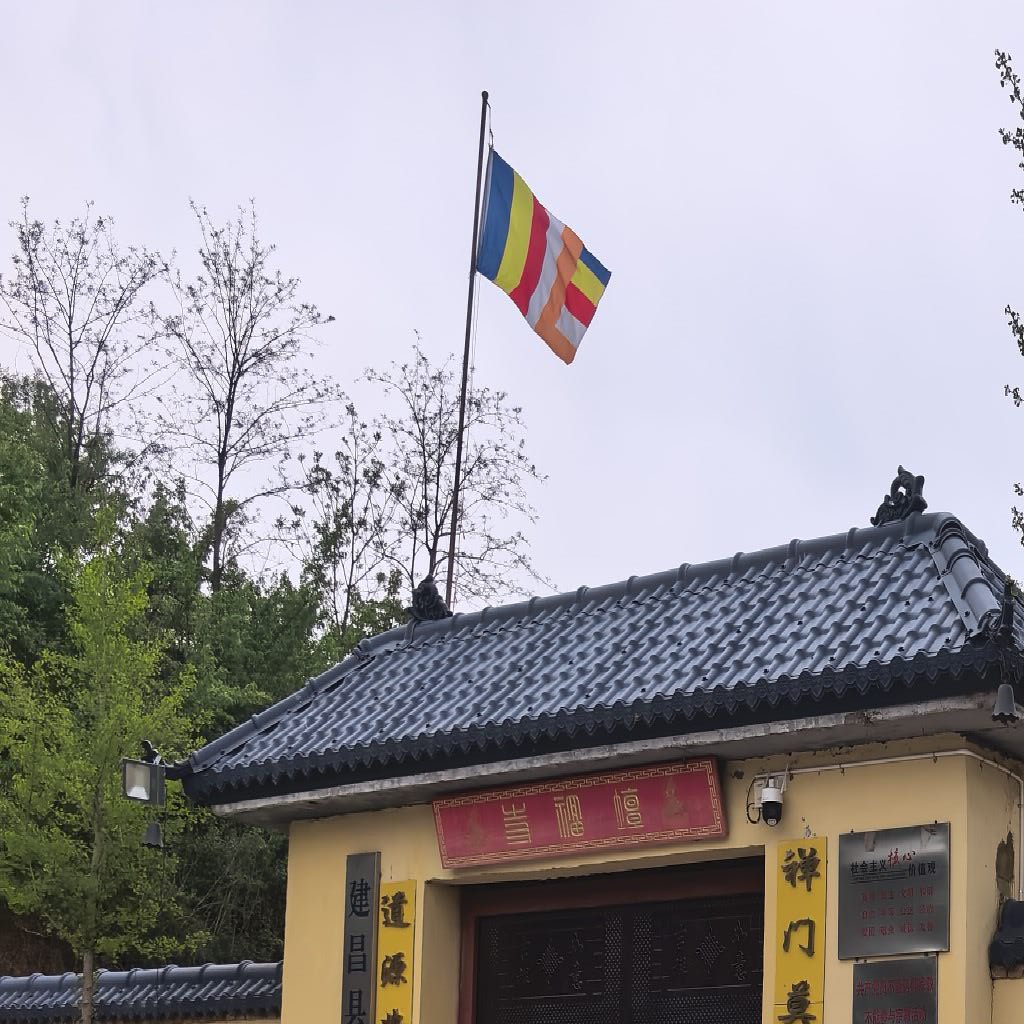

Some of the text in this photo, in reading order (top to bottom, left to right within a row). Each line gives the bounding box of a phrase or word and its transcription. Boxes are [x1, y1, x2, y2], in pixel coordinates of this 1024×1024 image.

[850, 847, 936, 877] 社会主义核心价值观
